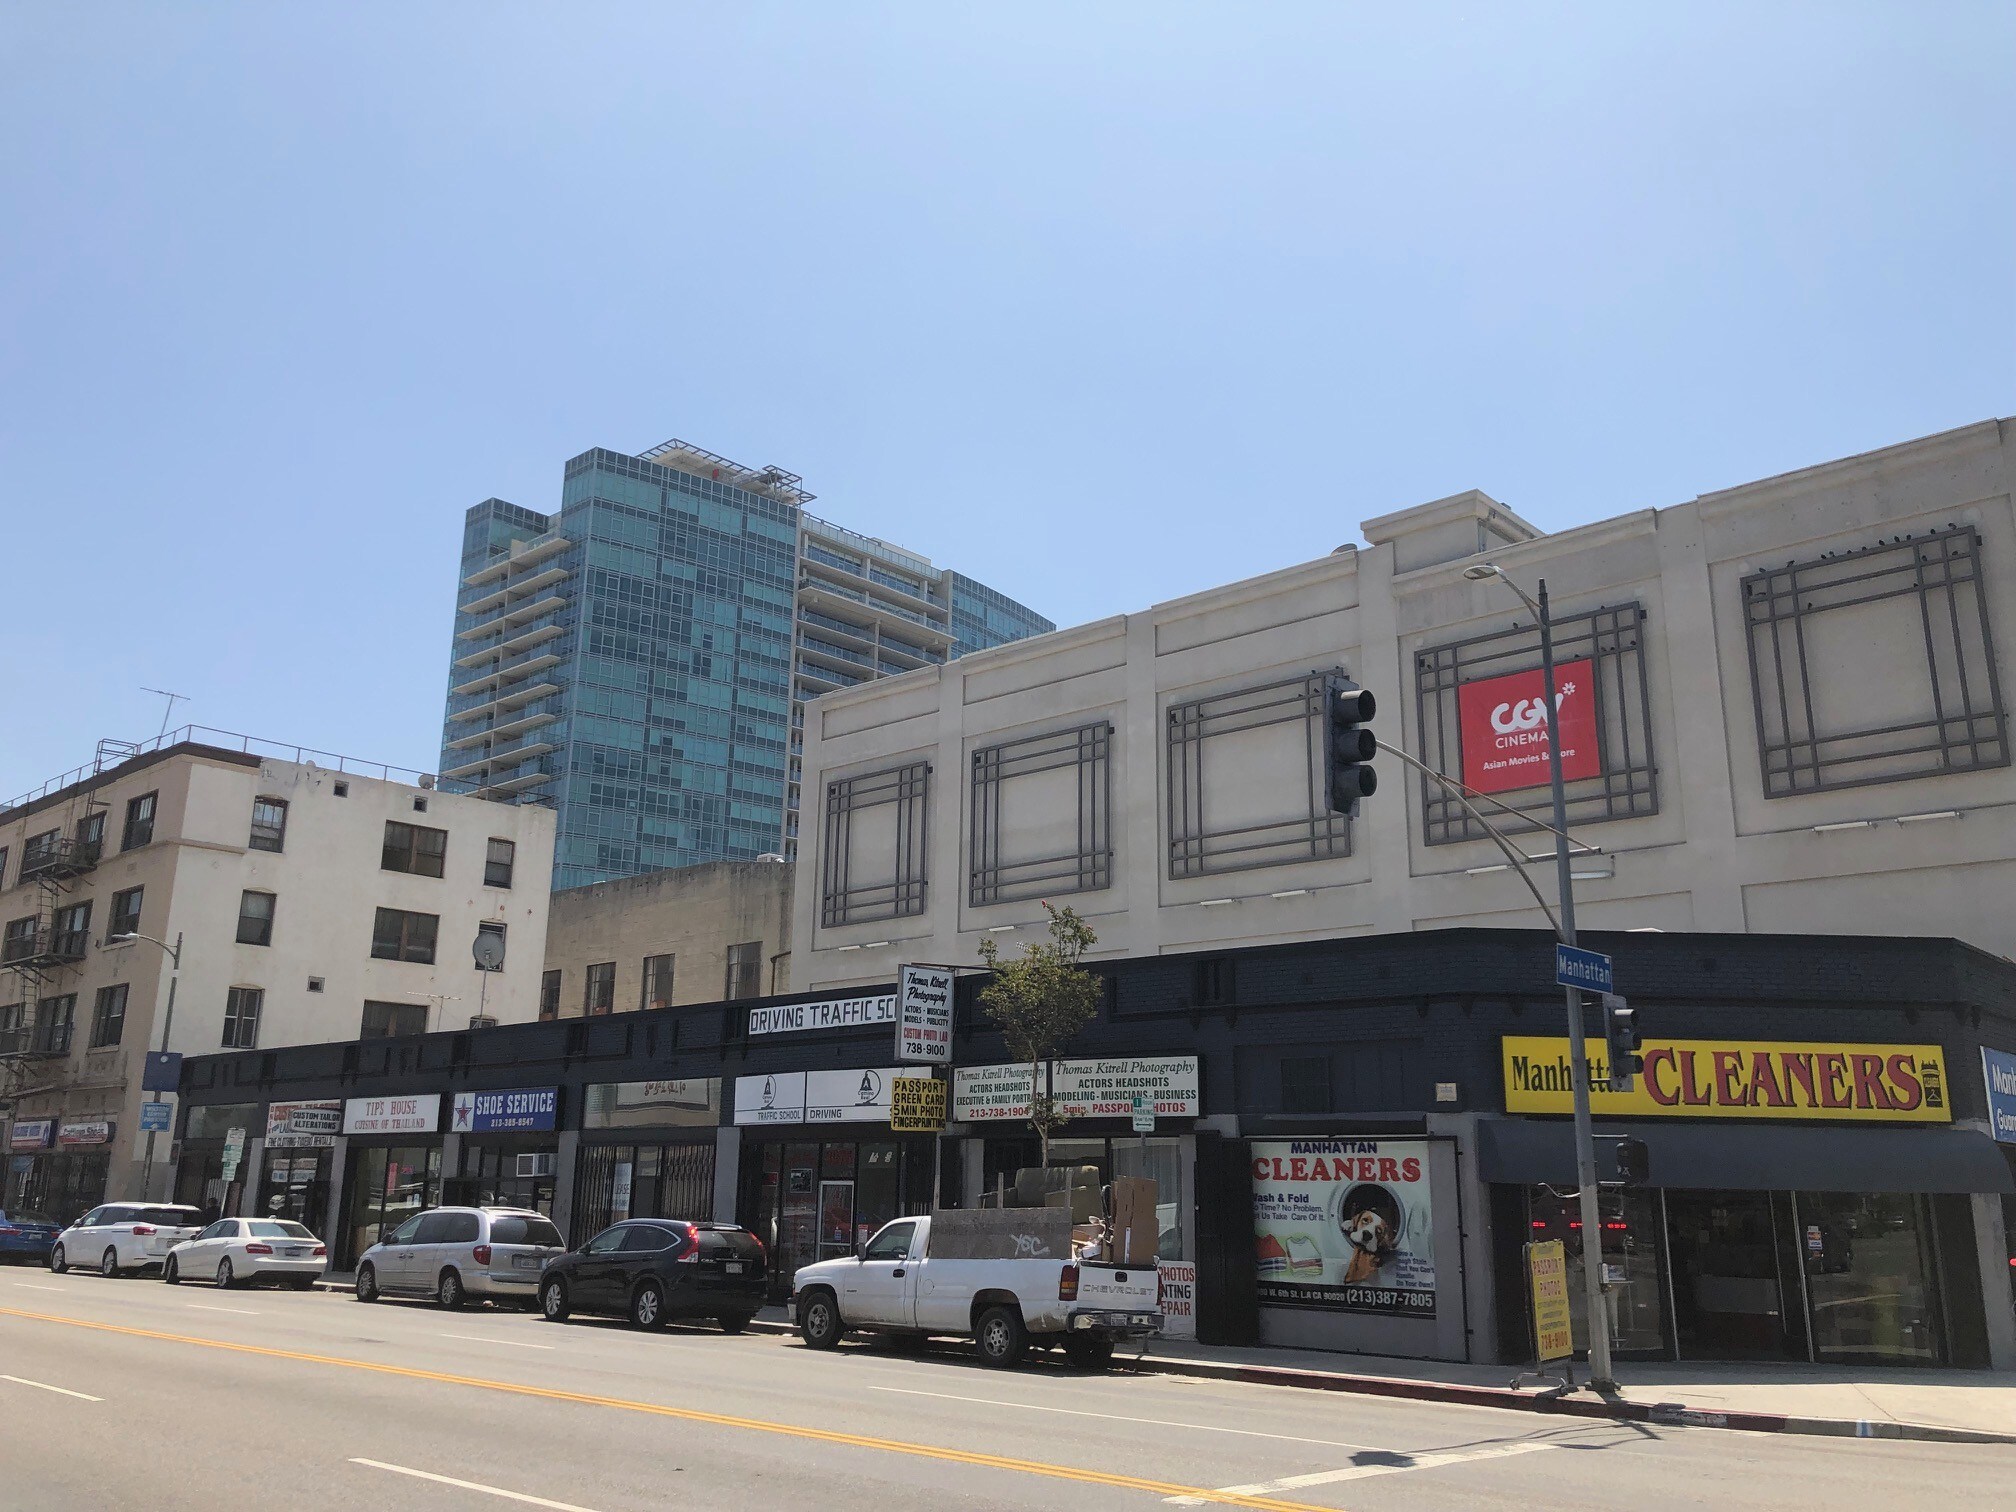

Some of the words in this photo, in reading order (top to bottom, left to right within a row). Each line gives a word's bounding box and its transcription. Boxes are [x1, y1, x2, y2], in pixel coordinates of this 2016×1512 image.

[1490, 693, 1564, 735] CGV
[1483, 760, 1507, 770] Asian
[1508, 754, 1540, 766] Movies
[1542, 751, 1550, 760] &
[1559, 954, 1611, 984] Manhattan
[906, 972, 928, 988] Thomas
[906, 986, 947, 1006] Photography
[750, 1006, 804, 1032] DRIVING
[810, 1000, 872, 1026] TRAFFIC
[904, 1005, 922, 1014] ACTORS
[926, 1007, 950, 1017] MUSICIANS
[904, 1015, 922, 1024] MODELS
[926, 1018, 949, 1026] PUBLICITY
[904, 1027, 922, 1040] CUSTOM
[924, 1029, 938, 1042] PHOTO
[940, 1030, 948, 1042] LAB
[906, 1042, 944, 1056] 738-9100
[1056, 1062, 1093, 1076] Thomas
[1096, 1062, 1128, 1074] Kitrell
[1130, 1060, 1196, 1074] Photography
[956, 1070, 980, 1082] Thomas
[1511, 1055, 1634, 1093] Manhtt
[1642, 1047, 1923, 1112] CLEANERS
[894, 1080, 946, 1093] PASSPORT
[968, 1084, 992, 1094] ACTORS
[994, 1082, 1030, 1092] HEADSHOTS
[1078, 1078, 1113, 1088] ACTORS
[1116, 1077, 1170, 1088] HEADSHOTS
[894, 1092, 922, 1104] GREEN
[925, 1094, 945, 1106] CARD
[956, 1096, 984, 1106] EXECUTIVE
[986, 1096, 990, 1104] &
[992, 1094, 1012, 1104] FAMILY
[1154, 1090, 1196, 1100] BUSINESS
[390, 1100, 418, 1116] HOUSE
[476, 1095, 504, 1116] SHOE
[506, 1092, 554, 1114] SERVICE
[1154, 1102, 1186, 1112] HOTOS
[292, 1112, 320, 1120] CUSTOM
[320, 1112, 341, 1122] TAILOR
[758, 1112, 778, 1120] TRAFFIC
[780, 1110, 801, 1120] SCHOOL
[810, 1109, 842, 1119] DRIVING
[920, 1106, 944, 1118] PHOTO
[970, 1106, 1030, 1118] 213-738-1904
[294, 1120, 336, 1130] ALTERATIONS
[354, 1120, 378, 1130] CUISINE
[381, 1120, 390, 1130] OF
[392, 1118, 426, 1129] THAILAND
[893, 1116, 946, 1128] FINGERPRINTING
[1290, 1142, 1378, 1154] MANHATTAN
[1252, 1157, 1422, 1182] CLEANERS
[1278, 1194, 1284, 1202] &
[1288, 1194, 1310, 1204] Fold
[1260, 1204, 1280, 1212] Time?
[1282, 1204, 1292, 1212] No
[1294, 1204, 1324, 1213] Problem.
[1262, 1212, 1270, 1220] Us
[1272, 1213, 1288, 1221] Take
[1309, 1214, 1317, 1222] Of
[1082, 1284, 1154, 1296] CHEVROLET
[1278, 1289, 1289, 1298] 6th
[1312, 1292, 1322, 1300] CA
[1324, 1292, 1345, 1302] 90020
[1346, 1288, 1433, 1308] (213)387-7805
[1160, 1300, 1192, 1316] EPAIR
